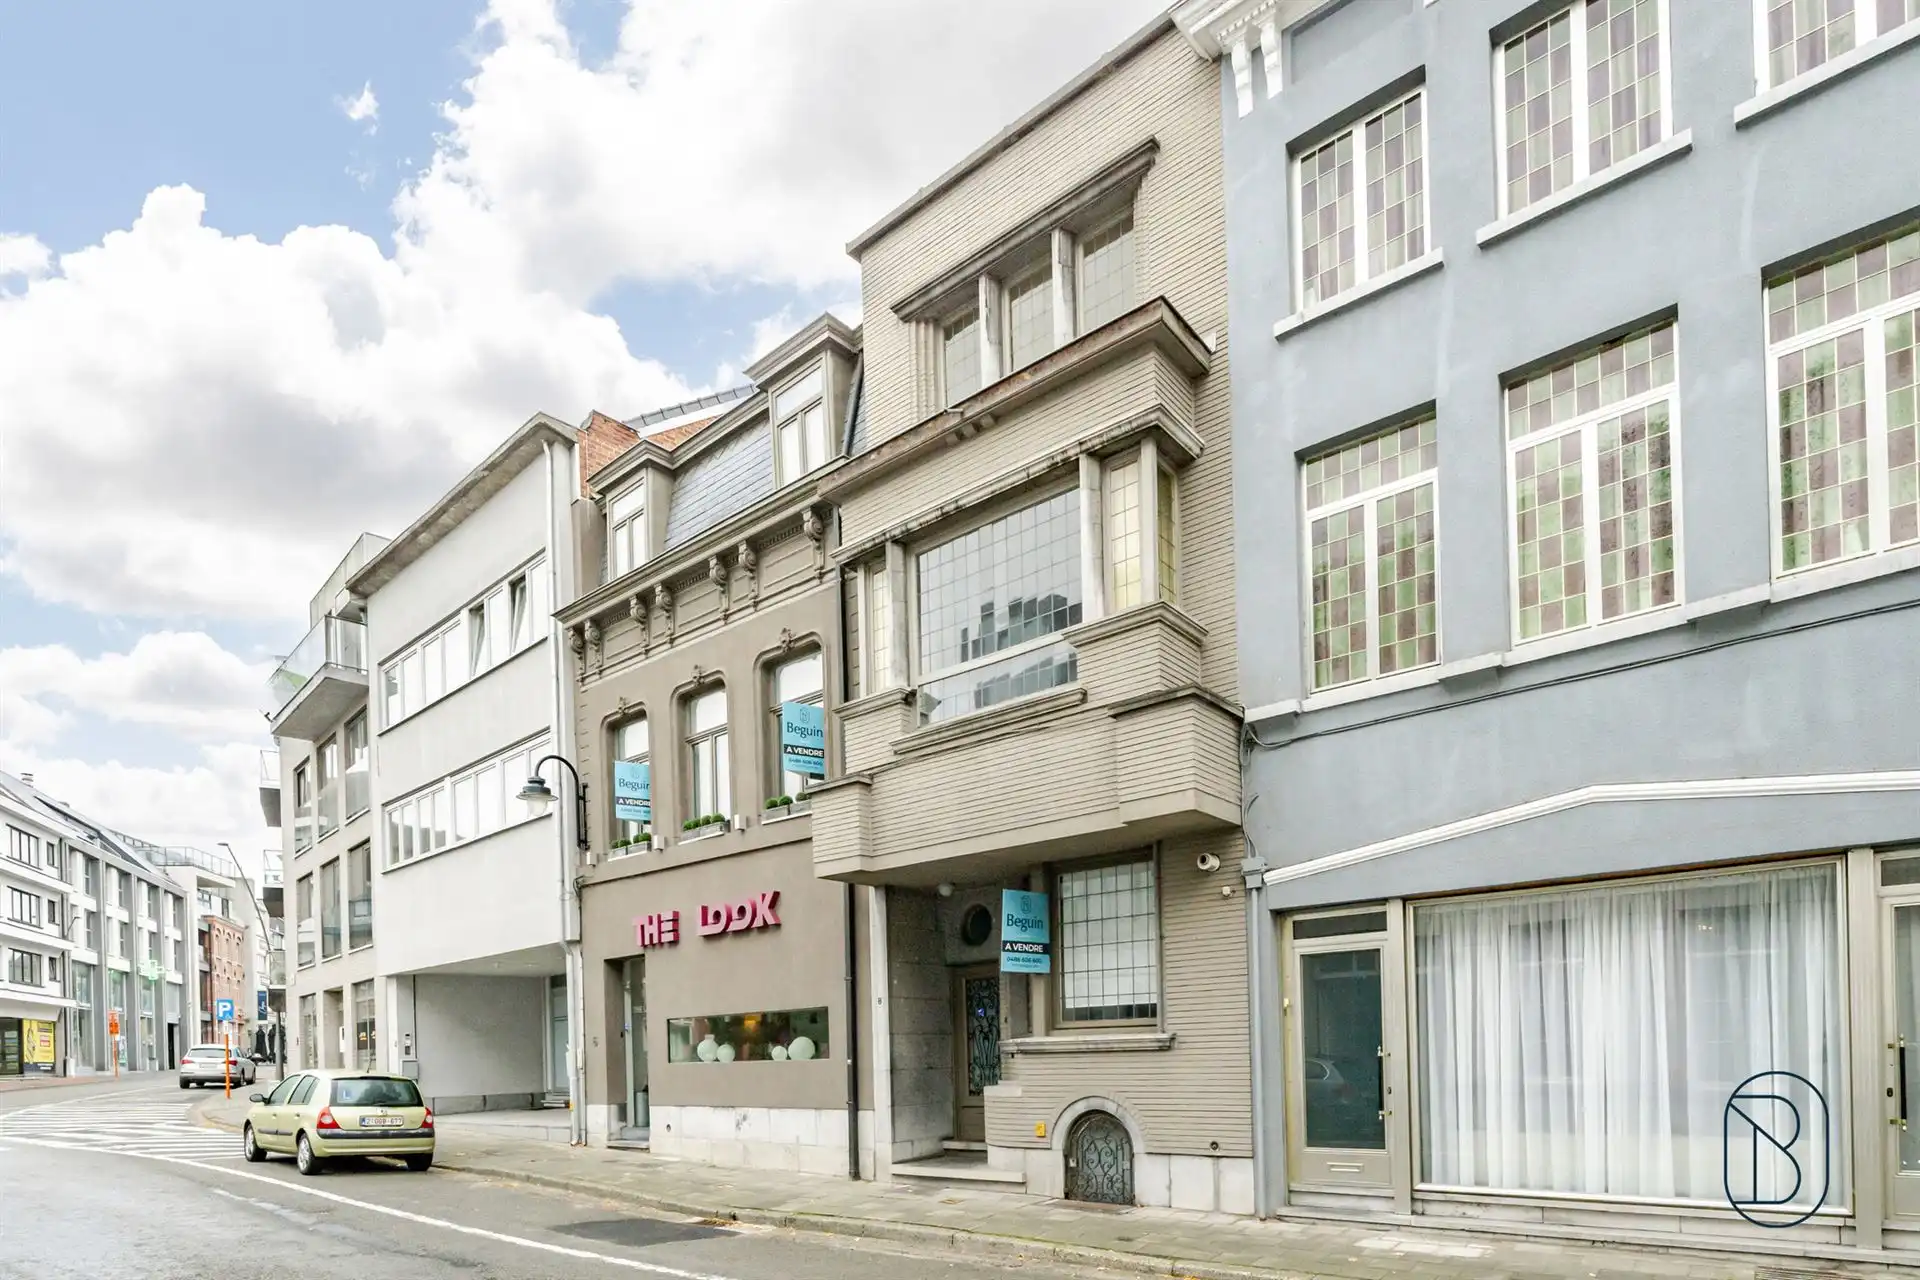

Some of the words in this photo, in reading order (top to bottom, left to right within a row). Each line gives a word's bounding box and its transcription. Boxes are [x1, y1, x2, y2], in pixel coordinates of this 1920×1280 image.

[786, 721, 823, 738] Beguin
[793, 747, 824, 756] VENDRE
[632, 910, 680, 948] THE
[697, 890, 781, 937] LOOK
[1006, 913, 1044, 932] Beguin
[1004, 942, 1012, 951] A
[1012, 943, 1044, 953] VENDRE
[218, 1002, 231, 1018] P
